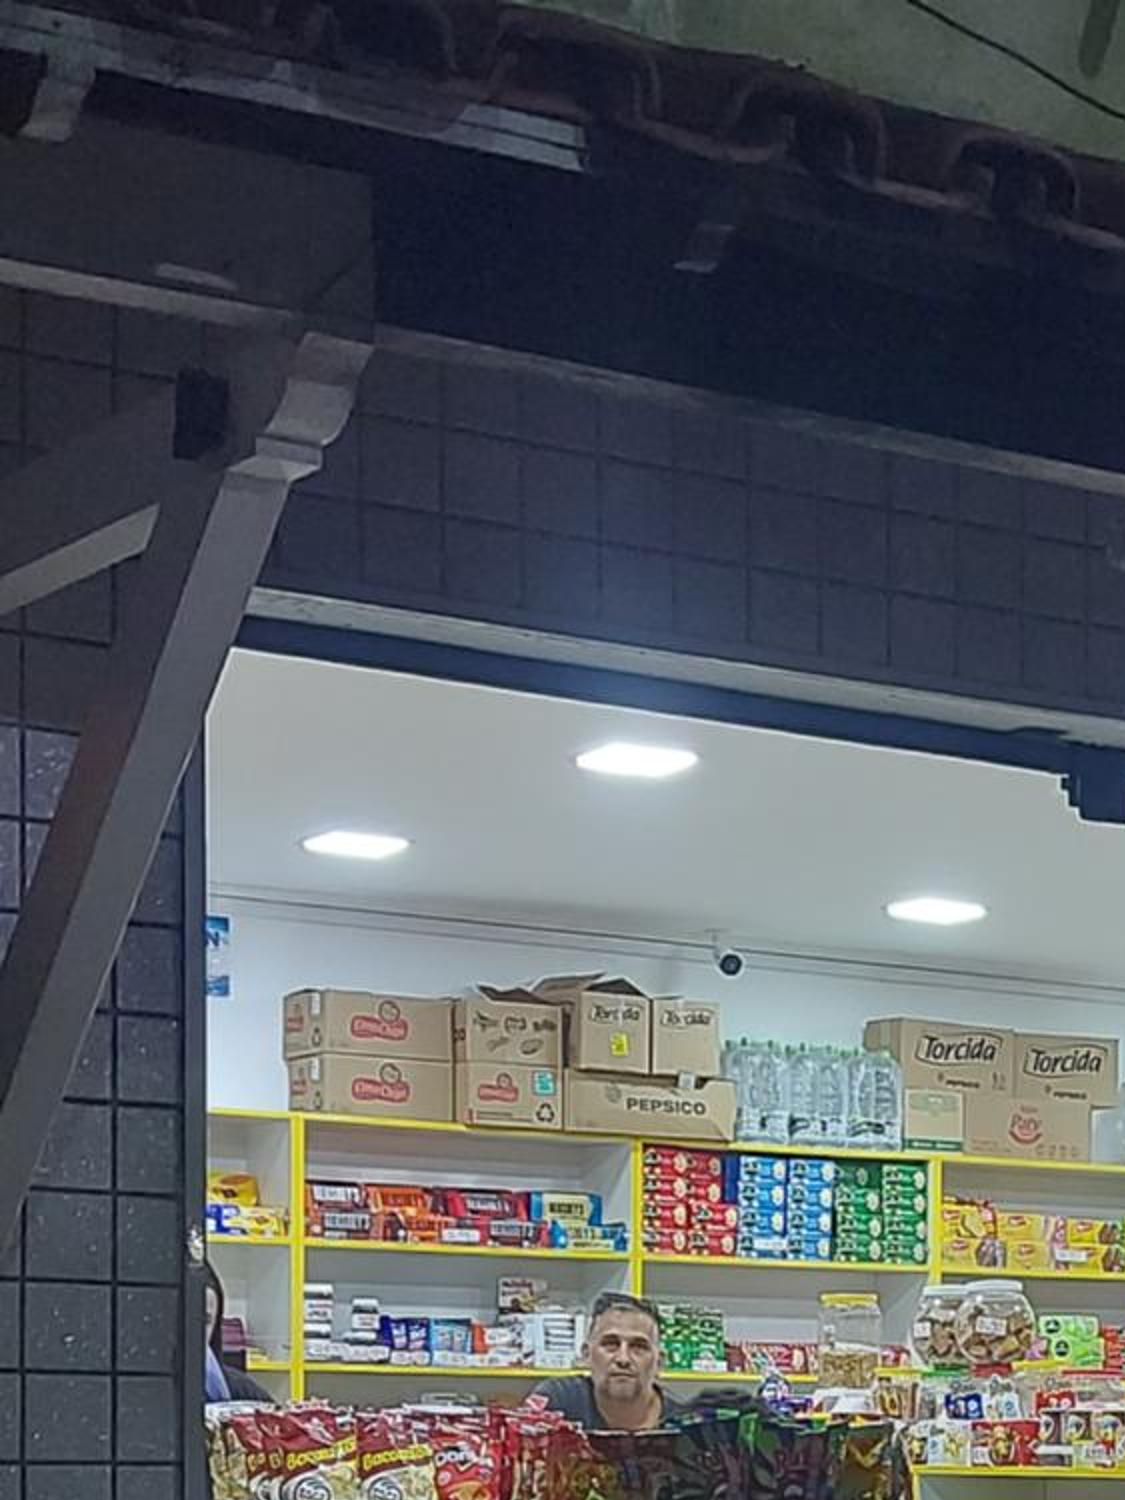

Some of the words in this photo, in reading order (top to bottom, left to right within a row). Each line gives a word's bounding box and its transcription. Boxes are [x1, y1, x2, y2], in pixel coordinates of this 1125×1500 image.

[923, 1035, 996, 1062] Torcida
[1031, 1048, 1101, 1073] Torcida
[626, 1097, 706, 1116] PEPSICO
